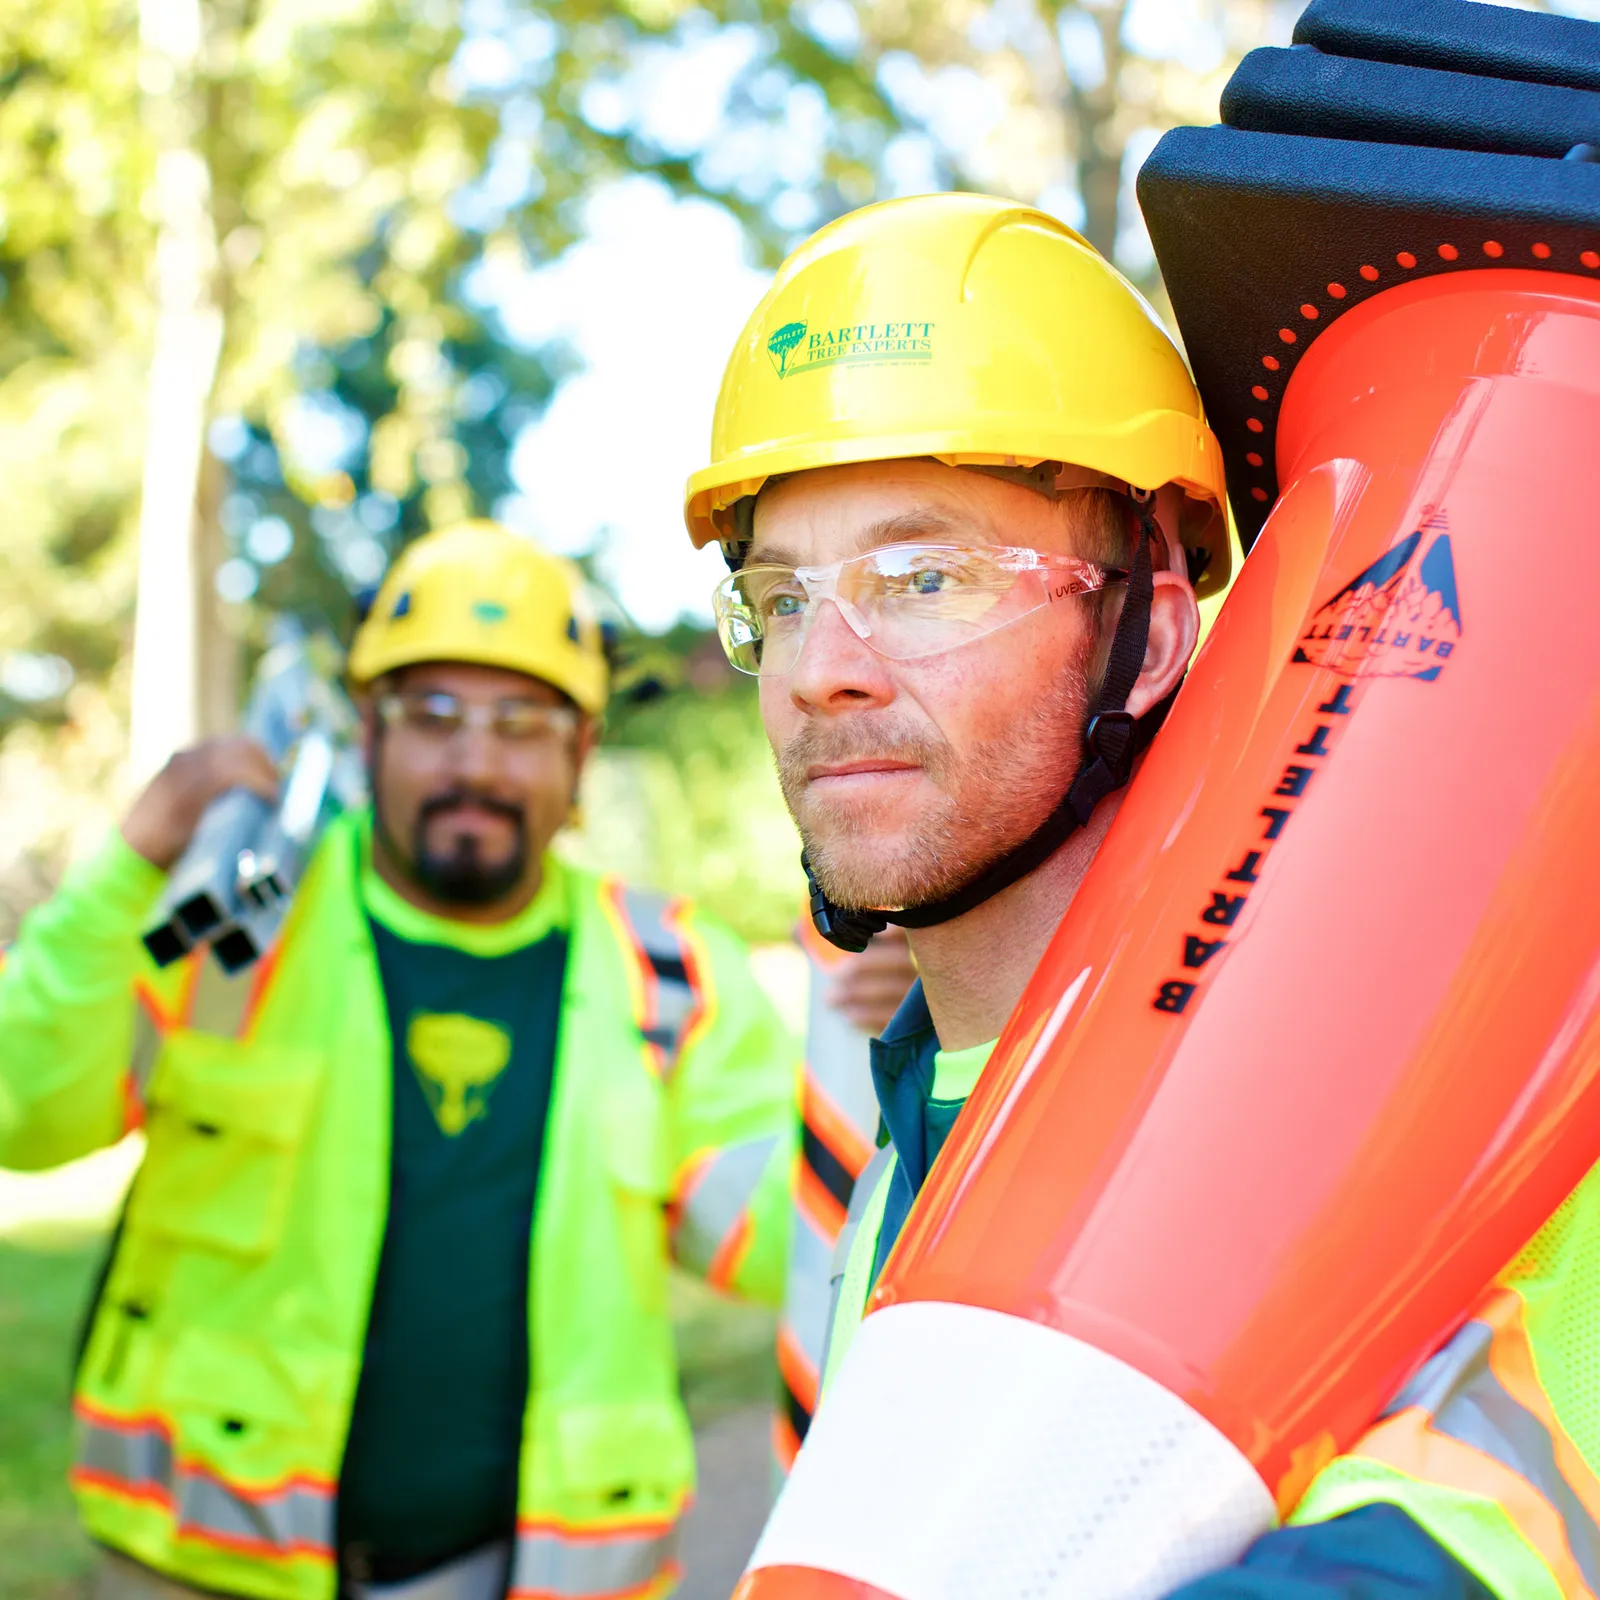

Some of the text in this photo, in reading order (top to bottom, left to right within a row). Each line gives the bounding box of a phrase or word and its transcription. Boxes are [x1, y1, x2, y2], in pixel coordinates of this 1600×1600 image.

[769, 327, 806, 346] BARTLETT
[808, 323, 935, 350] BARTLETT
[807, 339, 932, 361] TREE EXPERTS
[1055, 581, 1083, 598] UVEX
[1303, 624, 1455, 658] BARTLETT
[1153, 684, 1353, 1014] BARTLETT
